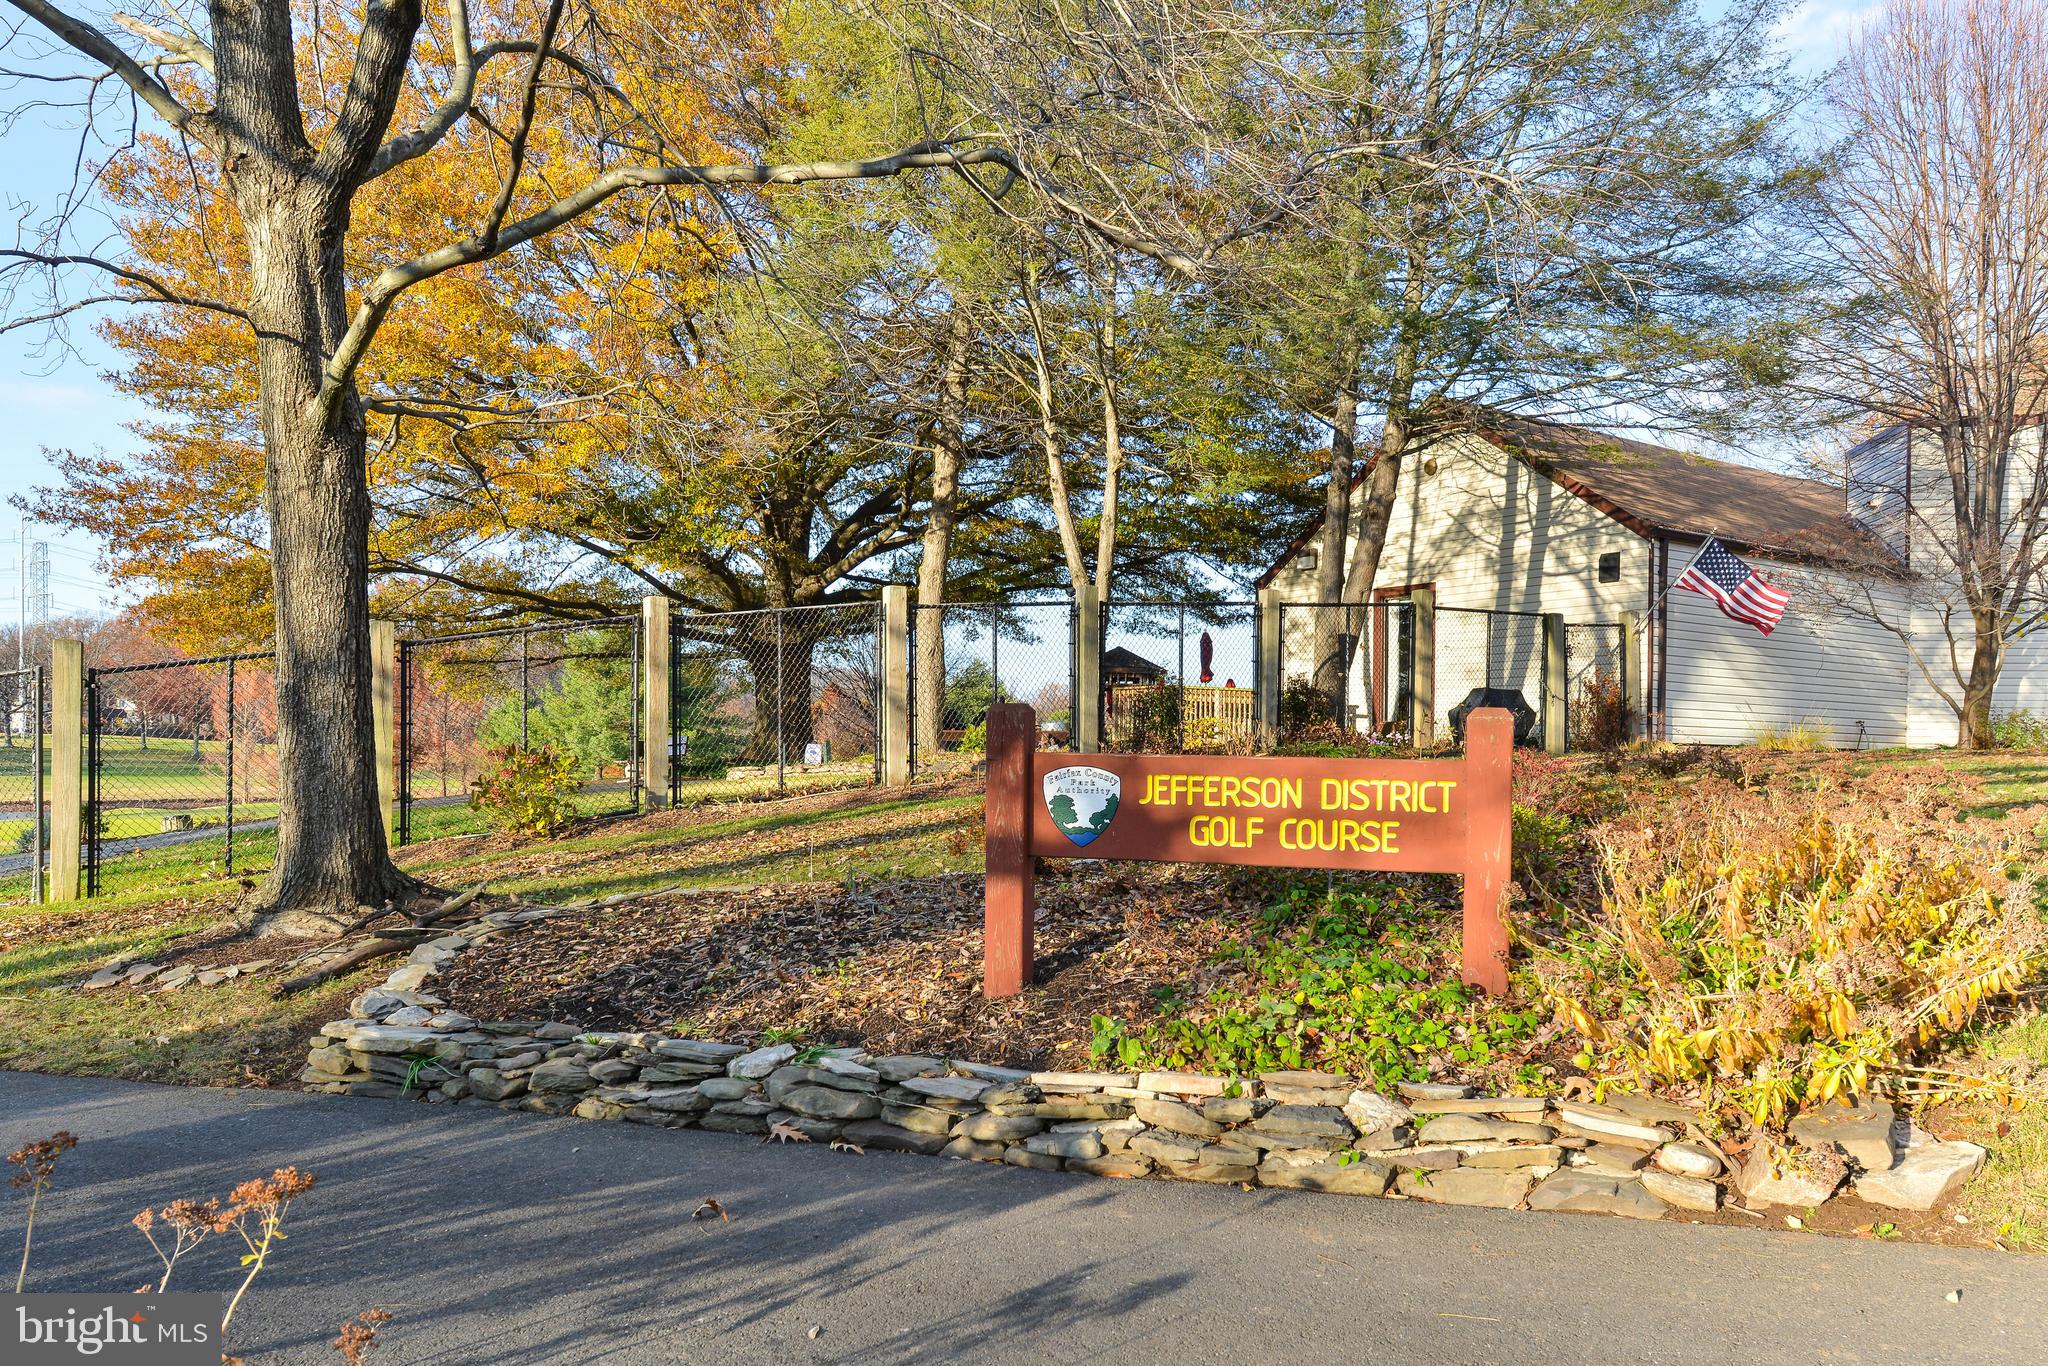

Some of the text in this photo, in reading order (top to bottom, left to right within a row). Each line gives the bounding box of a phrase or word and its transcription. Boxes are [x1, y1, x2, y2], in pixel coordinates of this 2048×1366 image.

[1047, 768, 1119, 786] Fairfax County
[1057, 786, 1110, 795] Authority
[1138, 774, 1457, 814] JEFFERSON DISTRICT
[1188, 815, 1401, 854] GOLF COURSE
